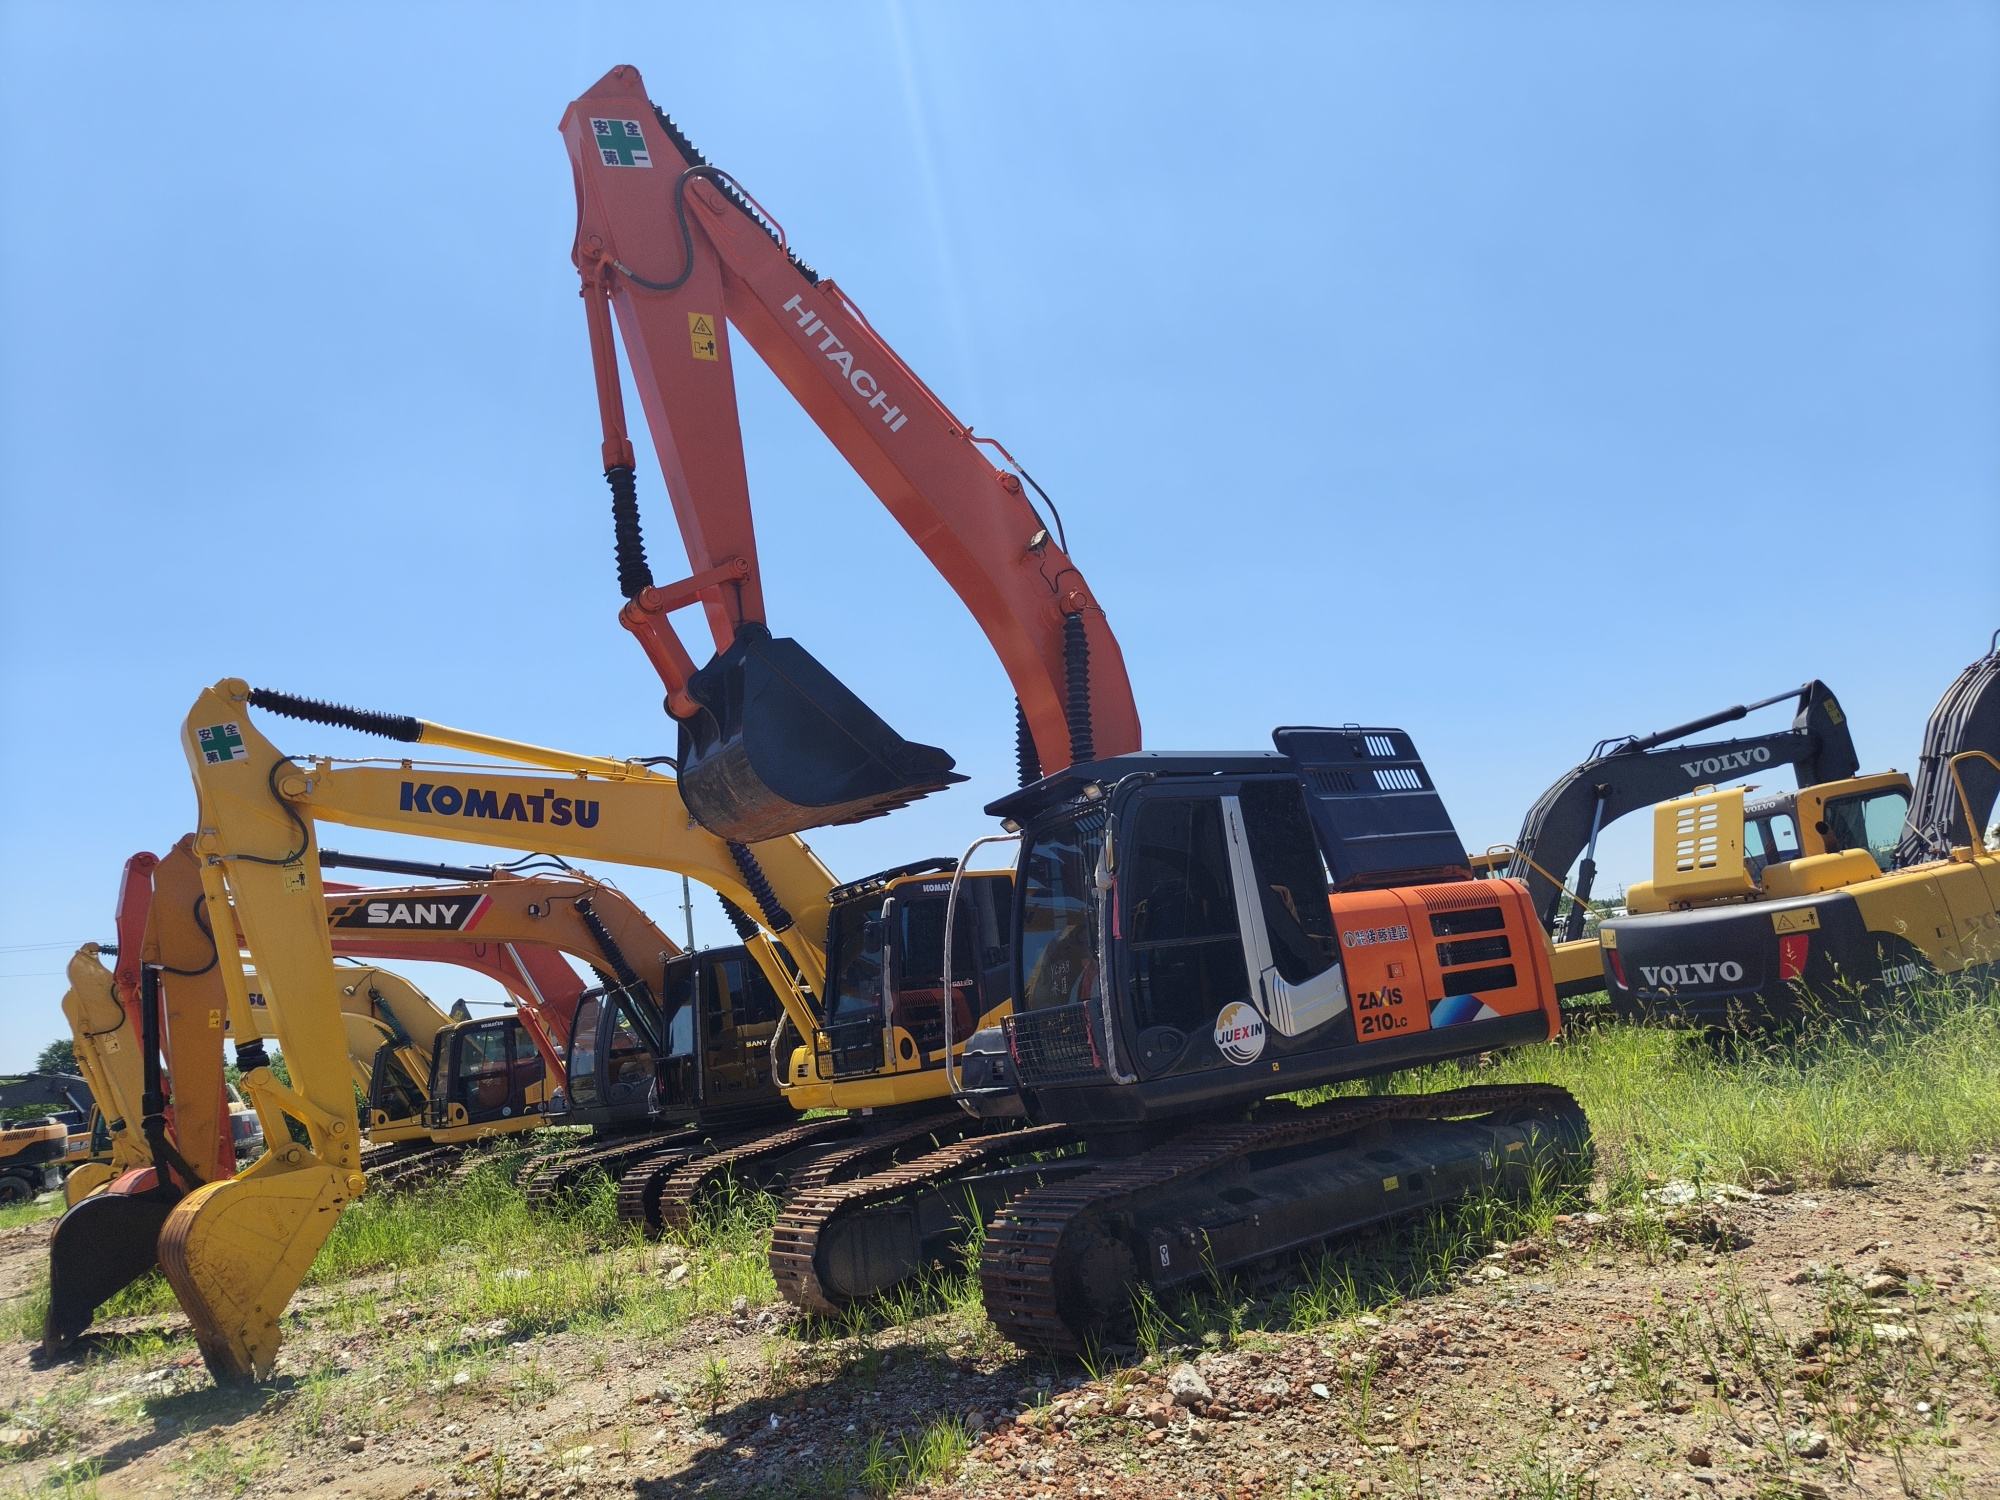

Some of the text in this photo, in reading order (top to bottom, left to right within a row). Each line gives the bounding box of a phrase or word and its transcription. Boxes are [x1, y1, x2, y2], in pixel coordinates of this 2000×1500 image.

[782, 294, 908, 433] HITACHI
[1680, 746, 1771, 778] VOLVO
[400, 781, 600, 829] KOMATSU
[1744, 801, 1776, 814] VOLVO
[922, 881, 953, 892] KOMAT
[367, 903, 460, 925] SANY
[1639, 961, 1743, 986] VOLVO
[1357, 985, 1403, 1011] ZAXIS
[745, 1039, 768, 1048] SANY
[1218, 1022, 1263, 1045] JUEXIN
